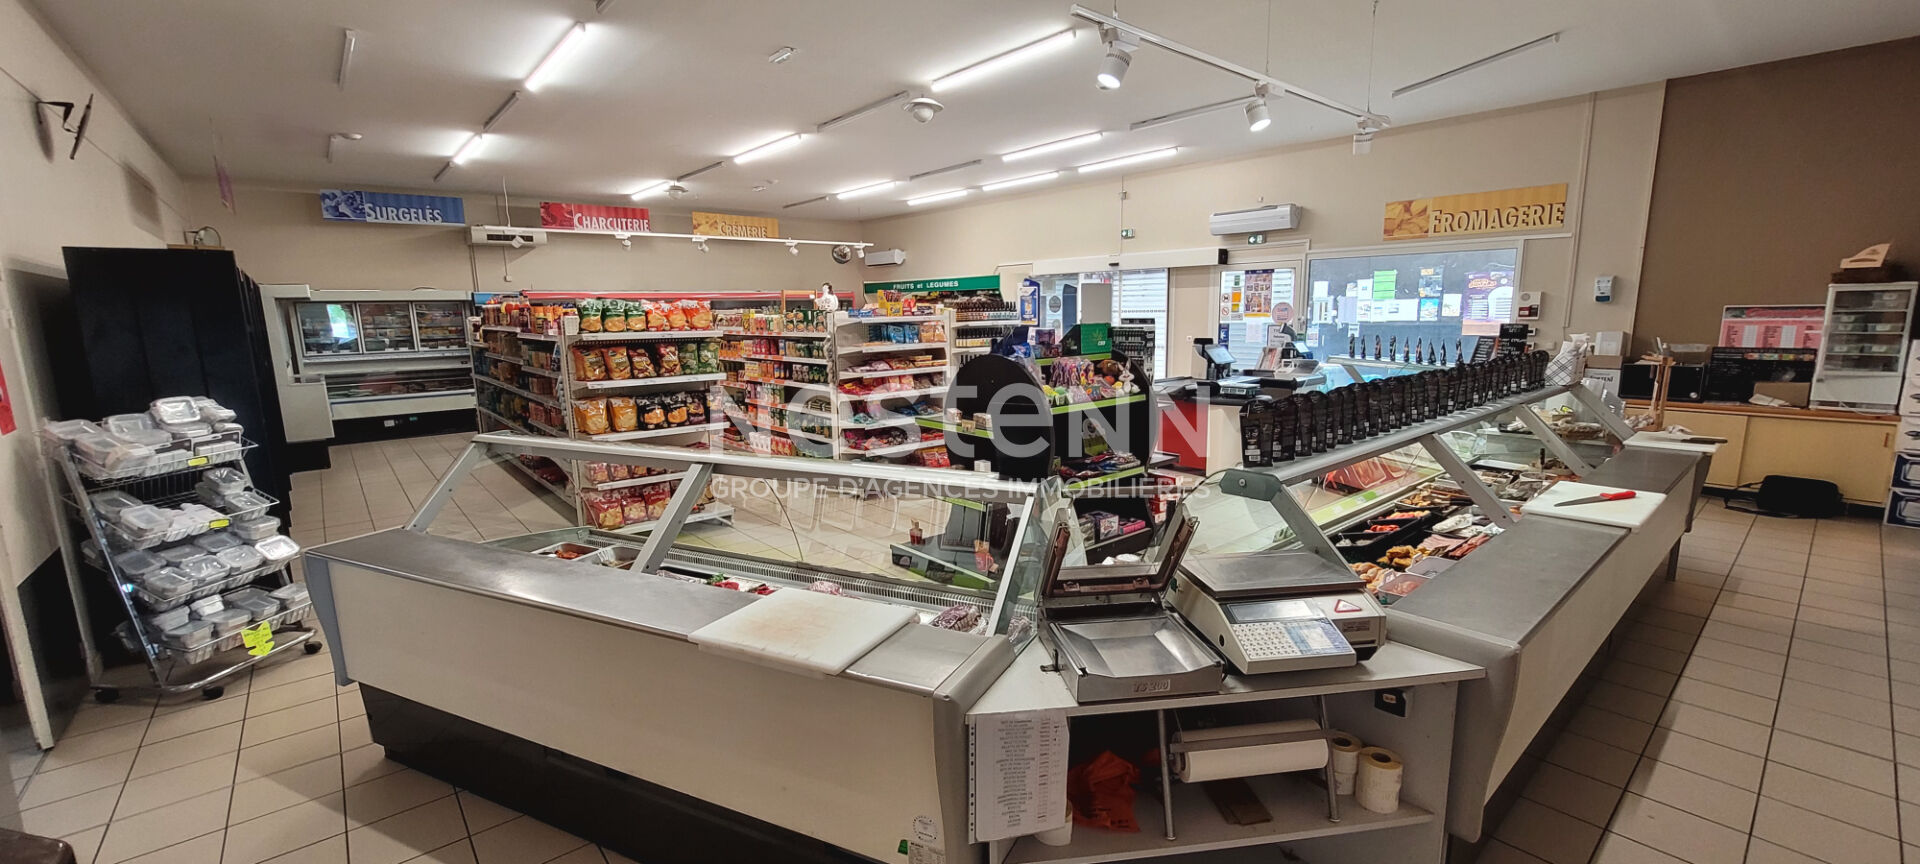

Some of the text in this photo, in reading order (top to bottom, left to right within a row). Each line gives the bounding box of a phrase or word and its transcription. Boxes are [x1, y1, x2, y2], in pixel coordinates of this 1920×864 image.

[365, 203, 443, 223] SURGELÉS
[574, 213, 650, 232] CHARCUTERIE
[1430, 202, 1566, 234] FROMAGERIE
